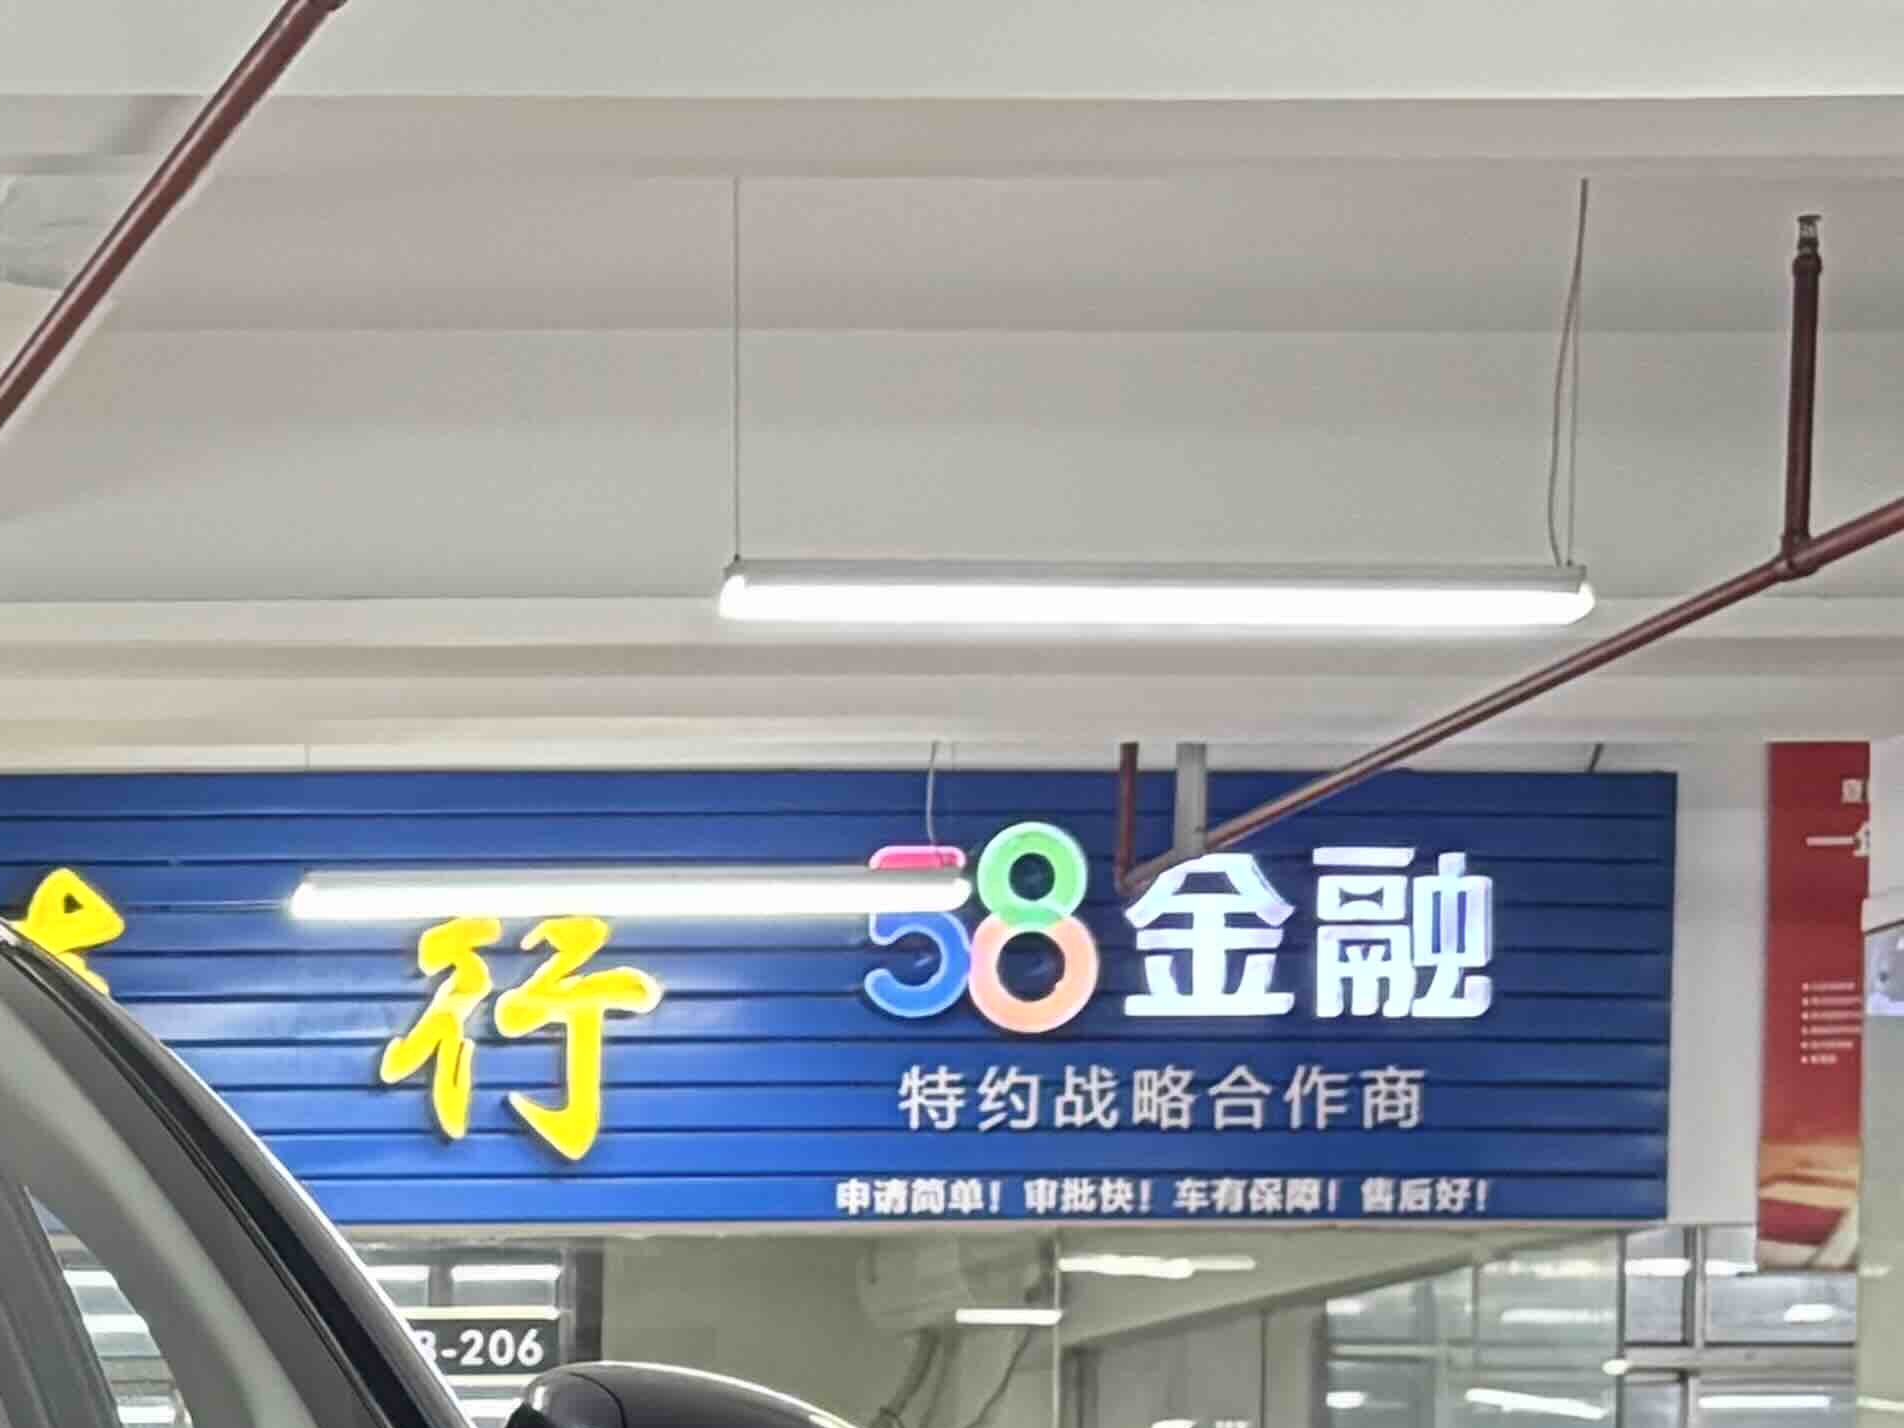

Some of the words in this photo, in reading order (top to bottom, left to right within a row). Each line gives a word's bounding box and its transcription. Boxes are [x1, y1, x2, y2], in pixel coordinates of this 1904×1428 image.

[897, 1064, 1427, 1130] 特约战略合作商
